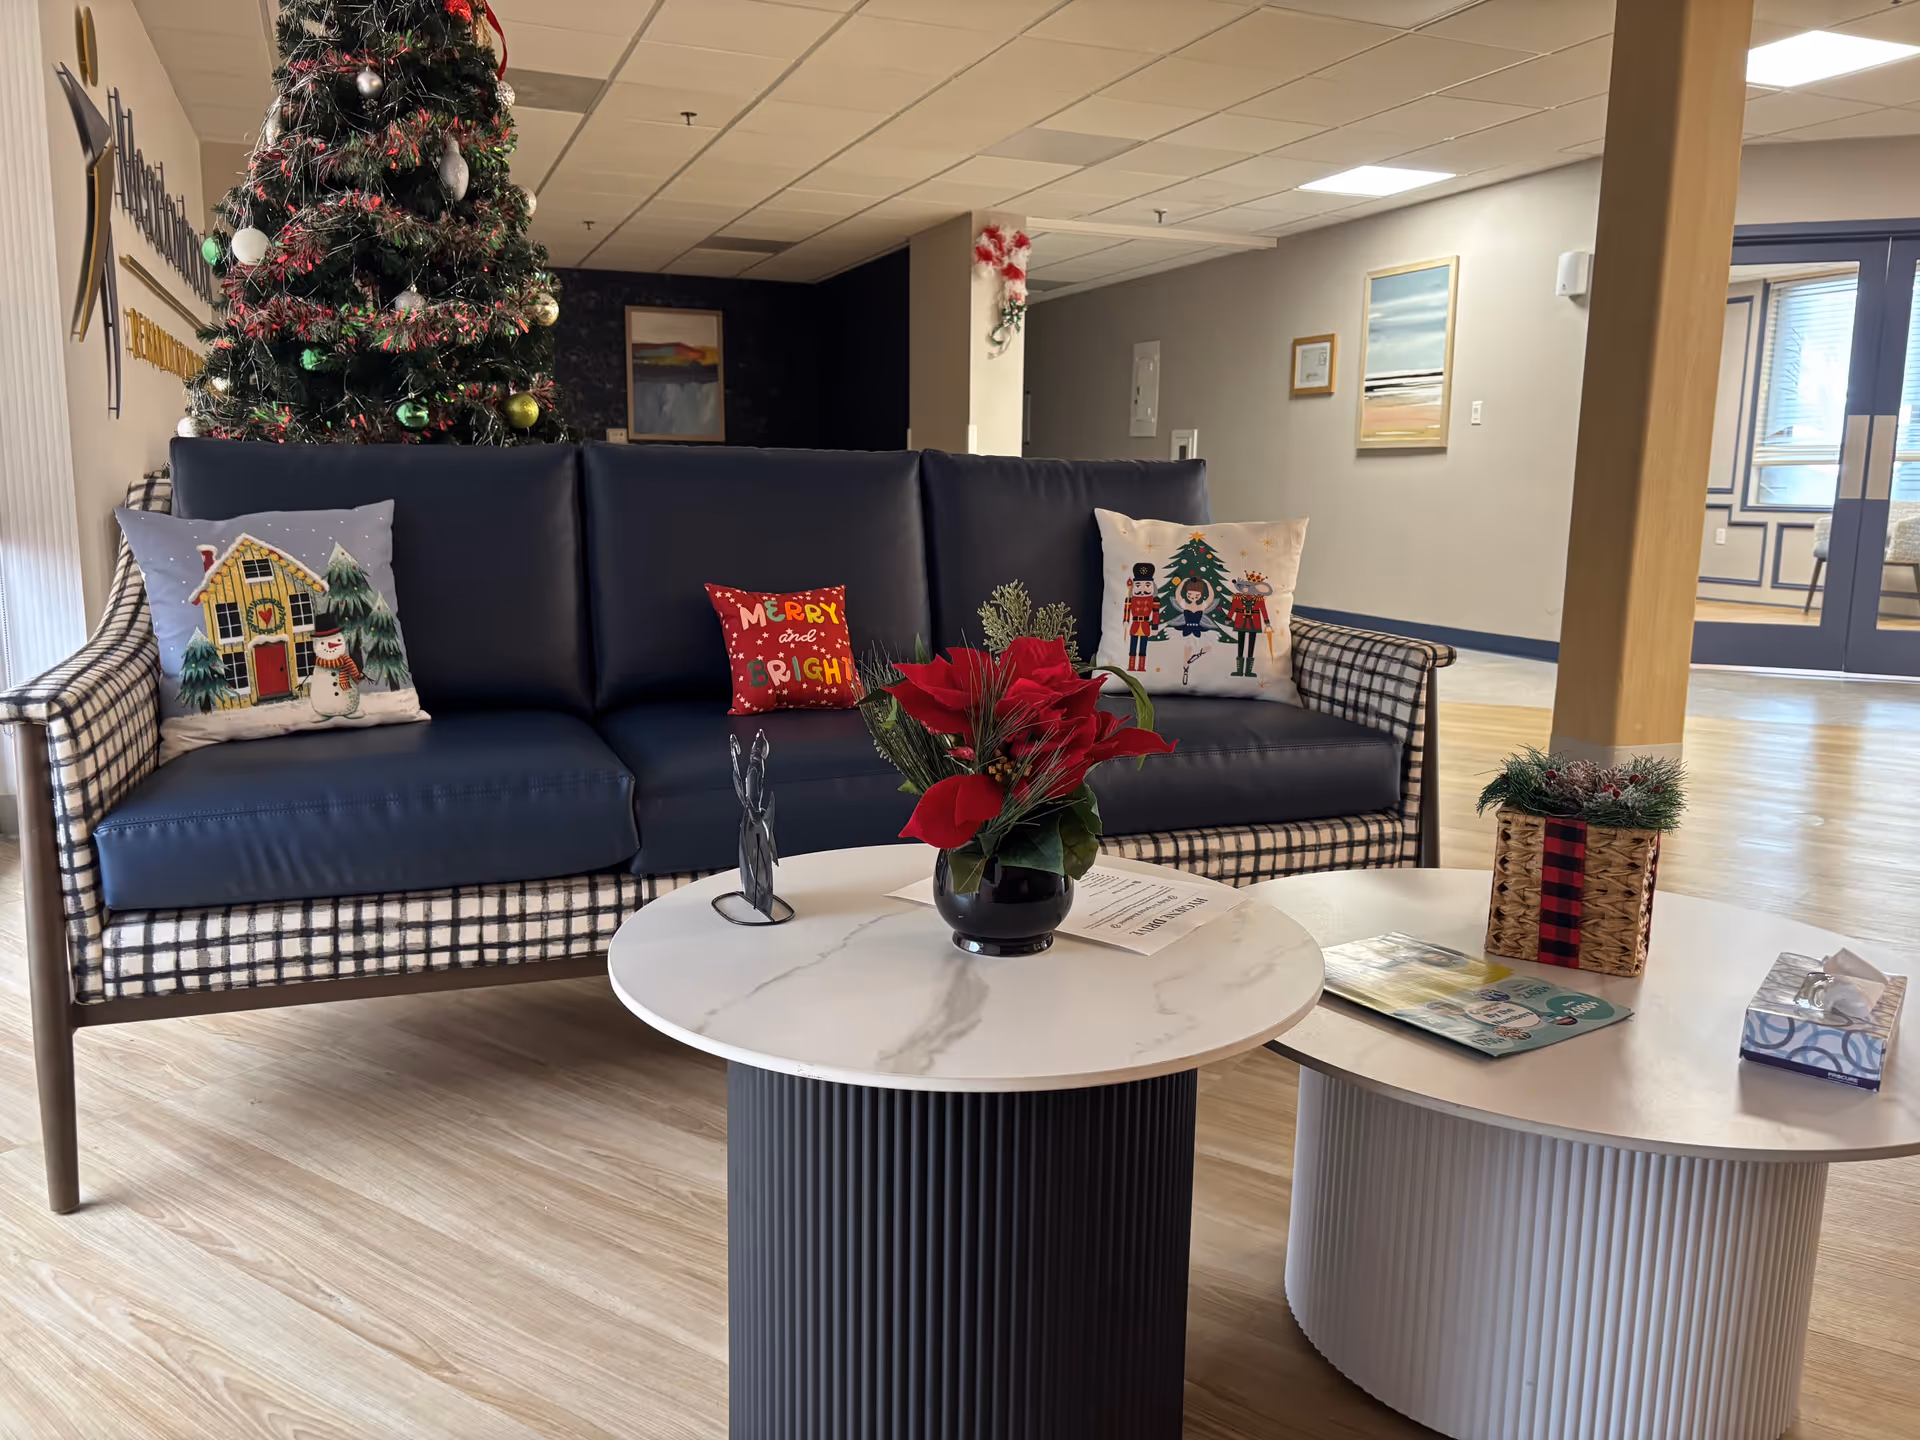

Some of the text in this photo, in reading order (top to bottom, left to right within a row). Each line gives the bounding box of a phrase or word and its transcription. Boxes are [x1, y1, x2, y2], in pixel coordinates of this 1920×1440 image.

[740, 601, 839, 630] MERRY
[779, 629, 817, 643] and
[1129, 918, 1168, 936] DRIVE
